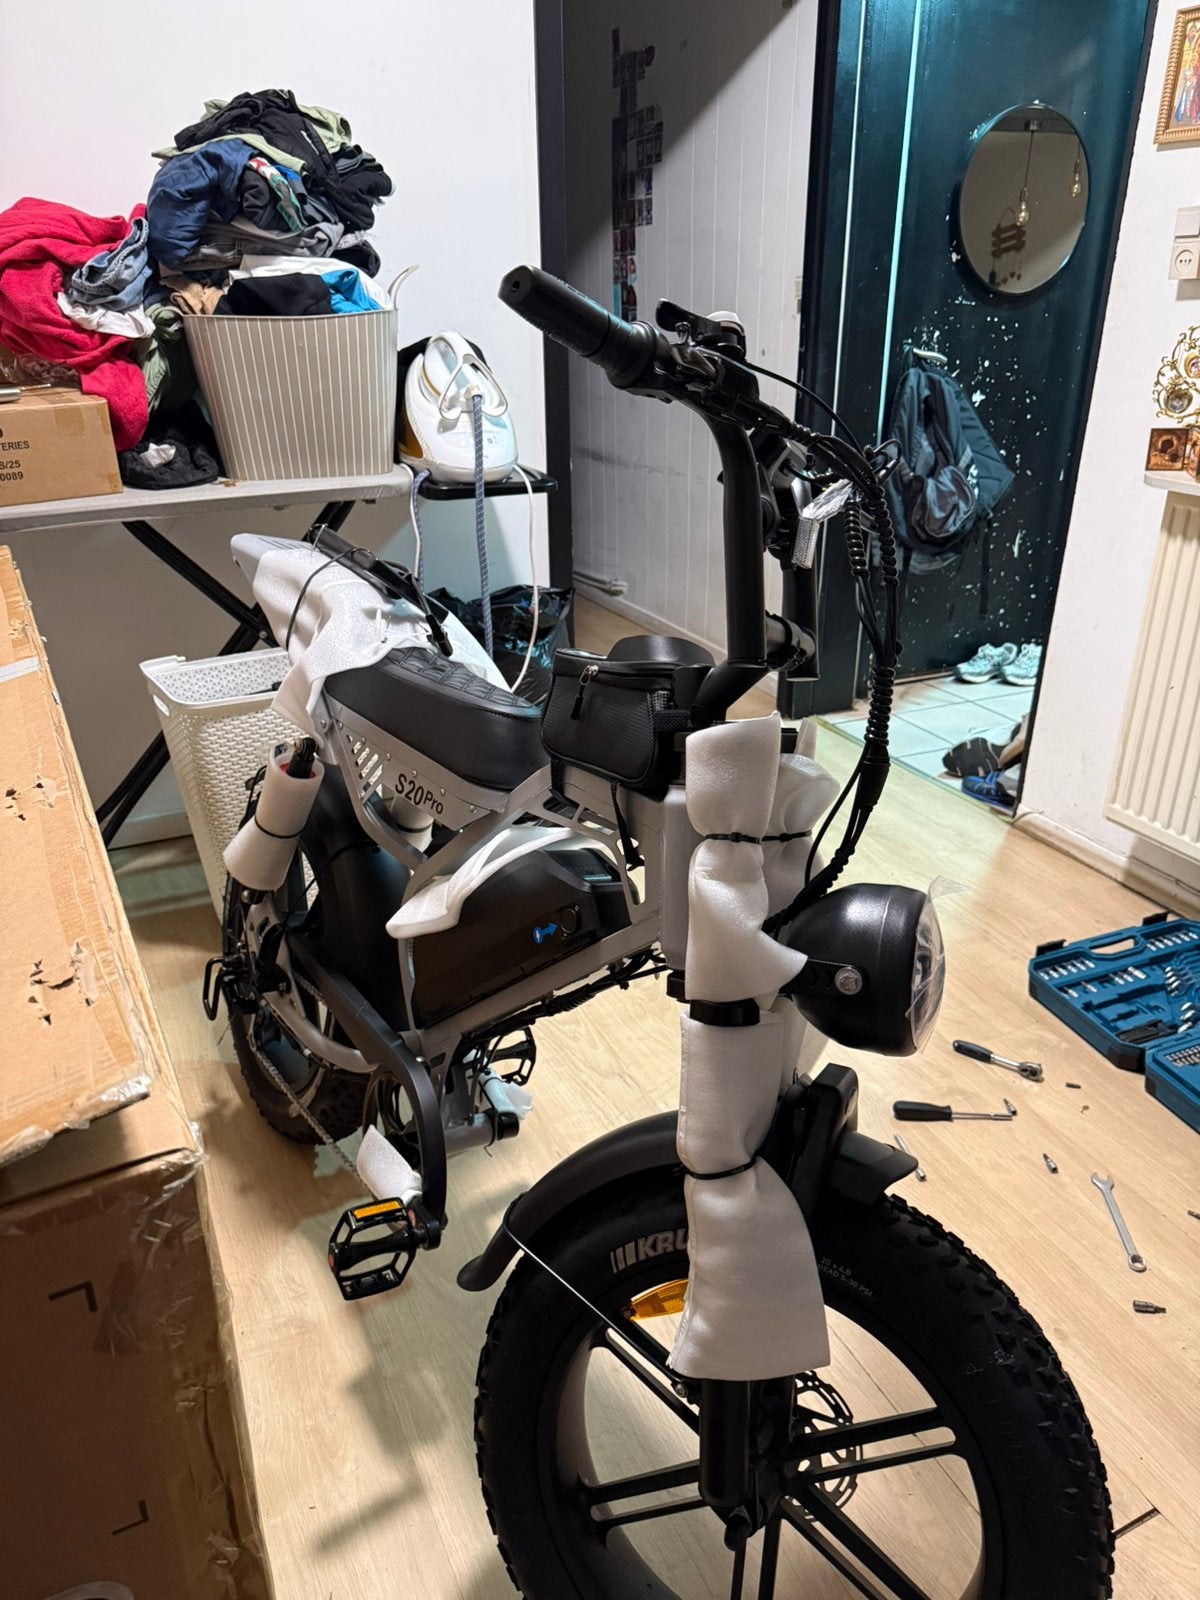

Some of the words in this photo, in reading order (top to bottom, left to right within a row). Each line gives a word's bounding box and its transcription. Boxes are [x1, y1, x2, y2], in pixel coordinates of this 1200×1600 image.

[0, 440, 30, 451] ERIES
[395, 773, 444, 815] S20Pro
[820, 1256, 831, 1266] 20
